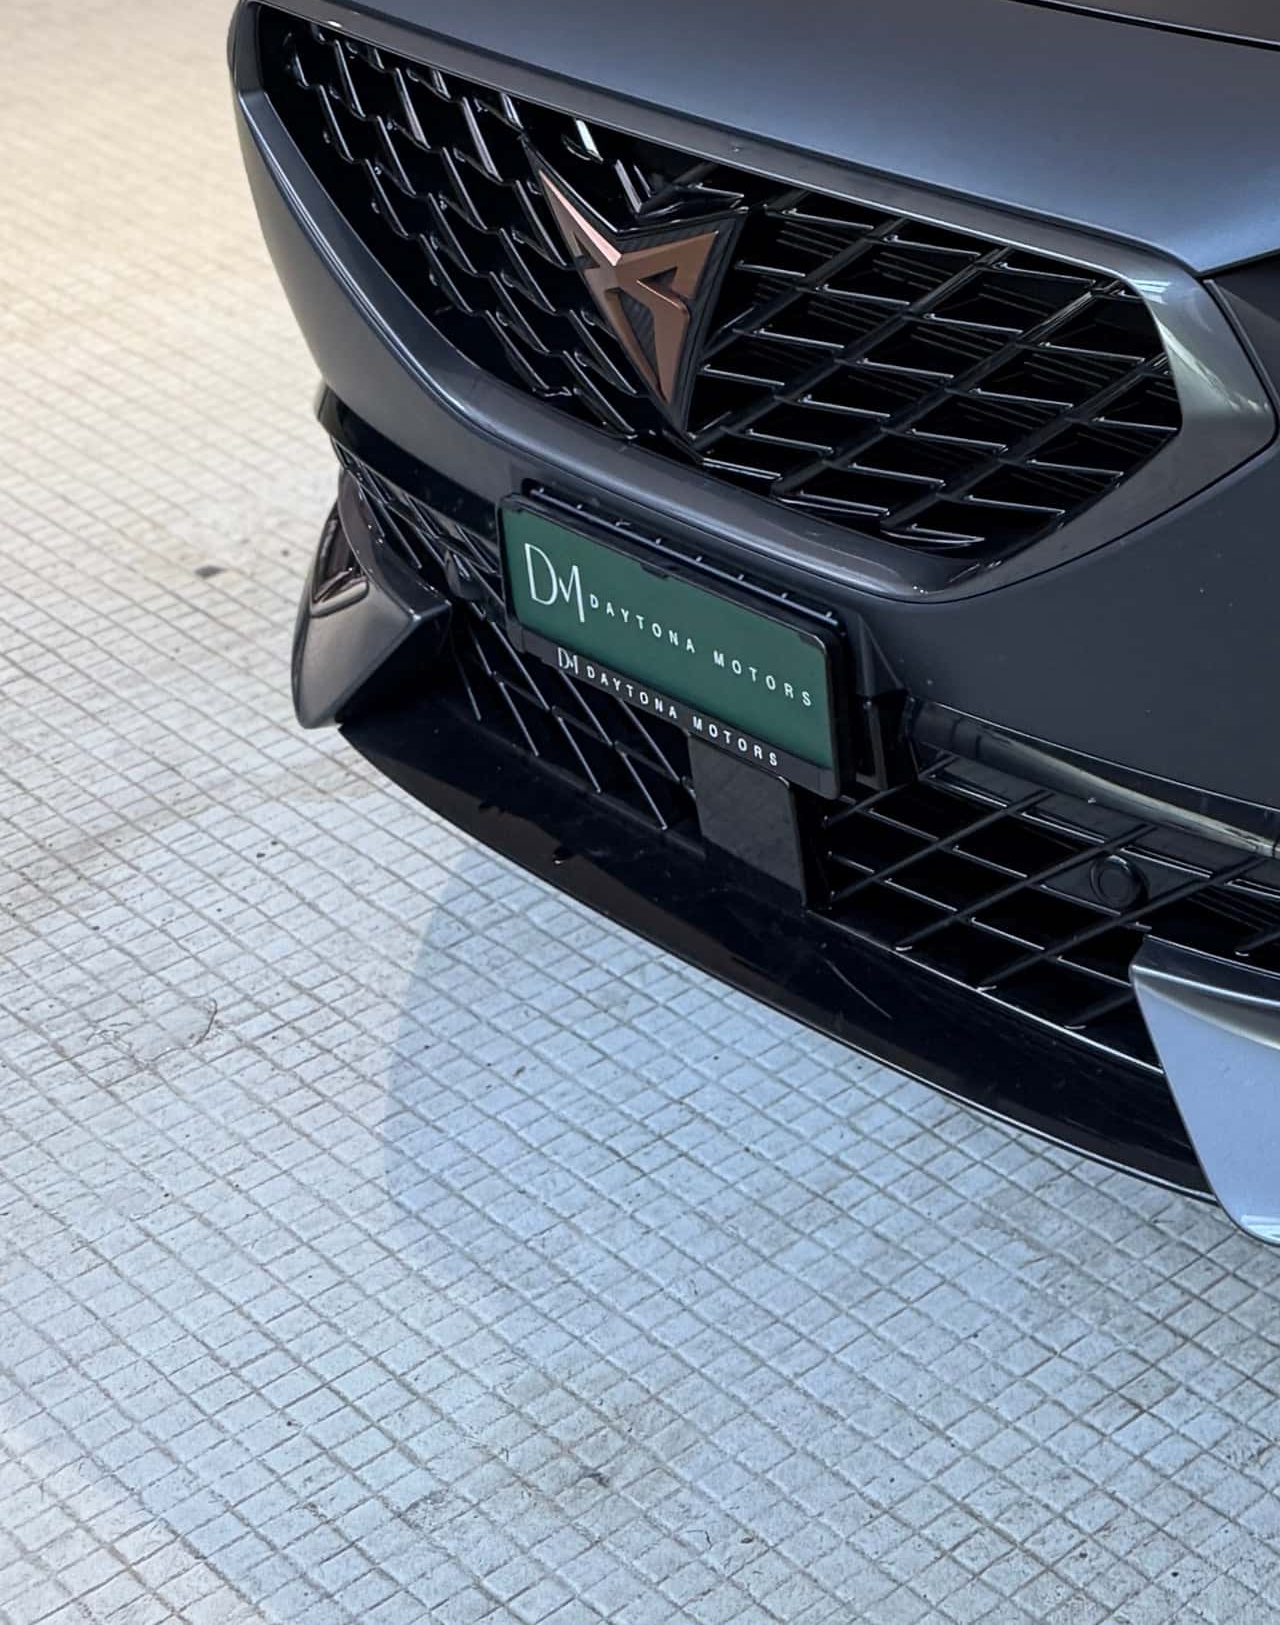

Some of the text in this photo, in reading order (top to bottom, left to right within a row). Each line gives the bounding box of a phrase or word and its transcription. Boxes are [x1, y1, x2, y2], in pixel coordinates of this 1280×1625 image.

[524, 542, 812, 707] DM DAYTONA MOTORS
[586, 665, 678, 719] DAYTONA
[692, 715, 778, 767] MOTORS
